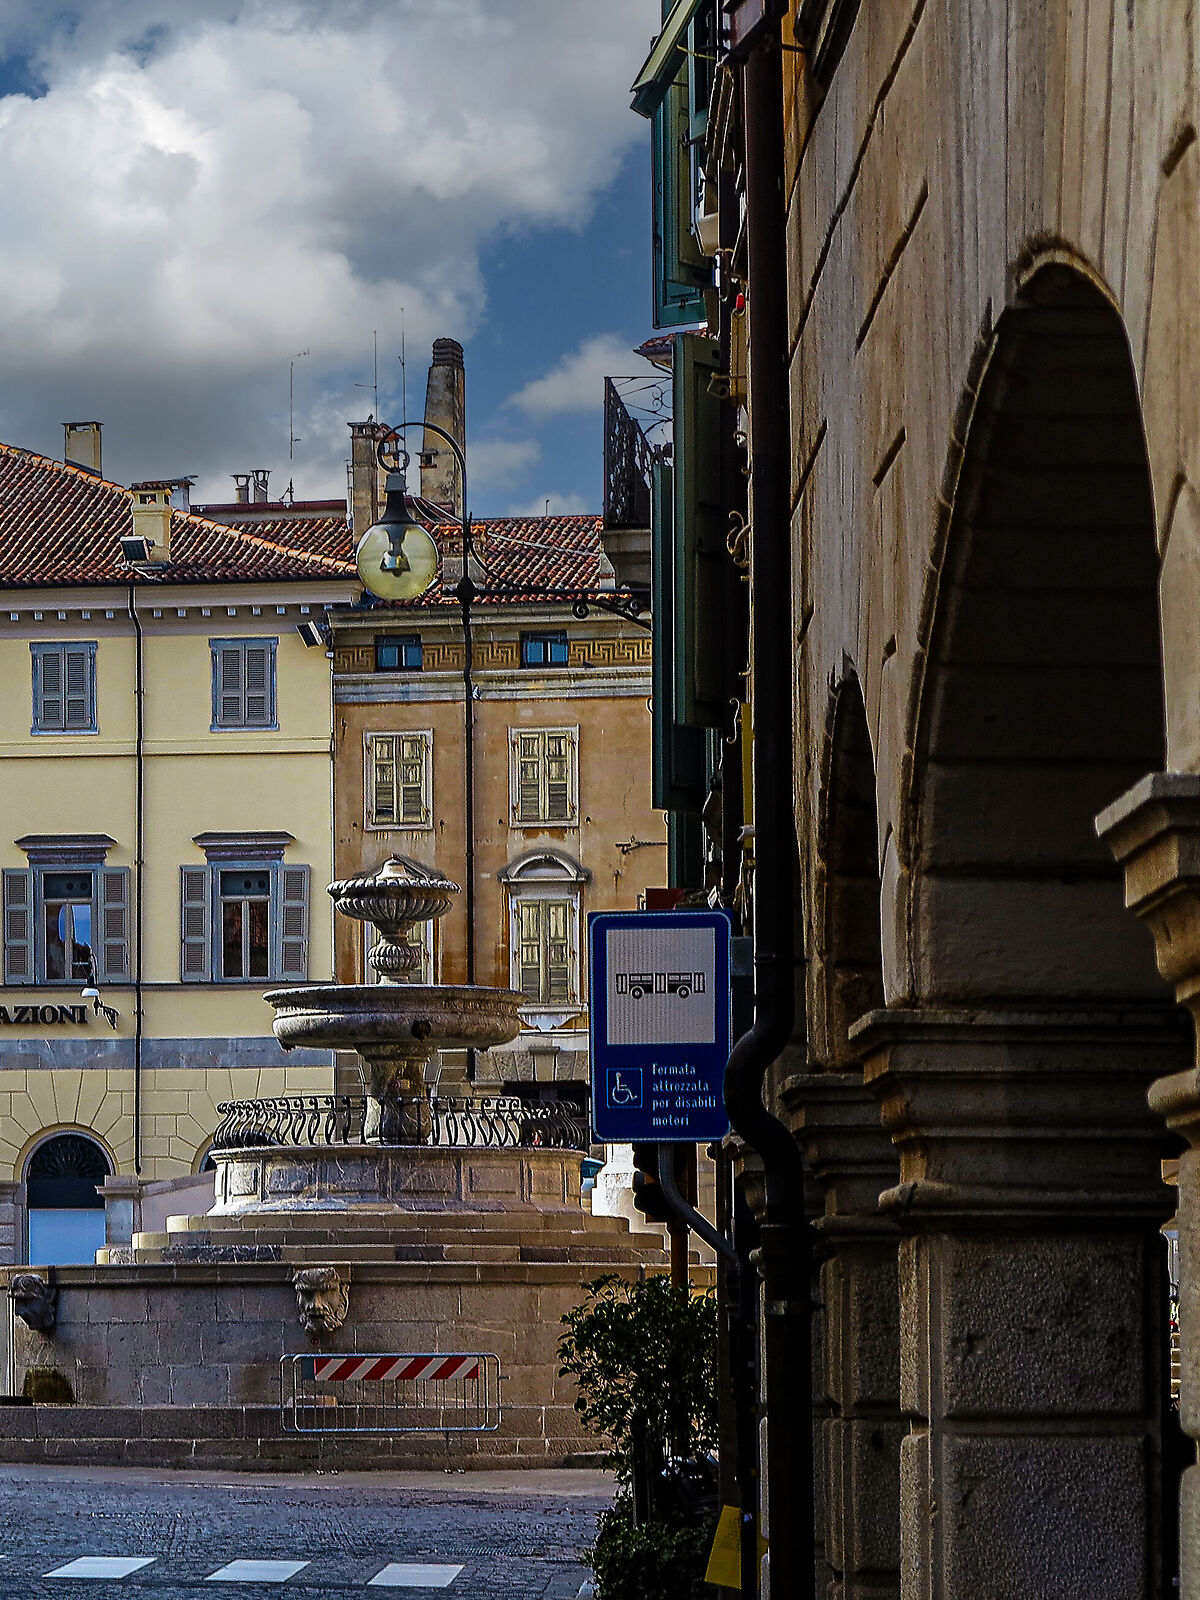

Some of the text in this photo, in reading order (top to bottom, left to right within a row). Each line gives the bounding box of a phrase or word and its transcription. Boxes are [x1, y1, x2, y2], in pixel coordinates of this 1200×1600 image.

[652, 1062, 696, 1075] Fermata
[652, 1079, 710, 1092] attrezzata
[652, 1095, 716, 1111] per disabili
[652, 1113, 689, 1126] motori
